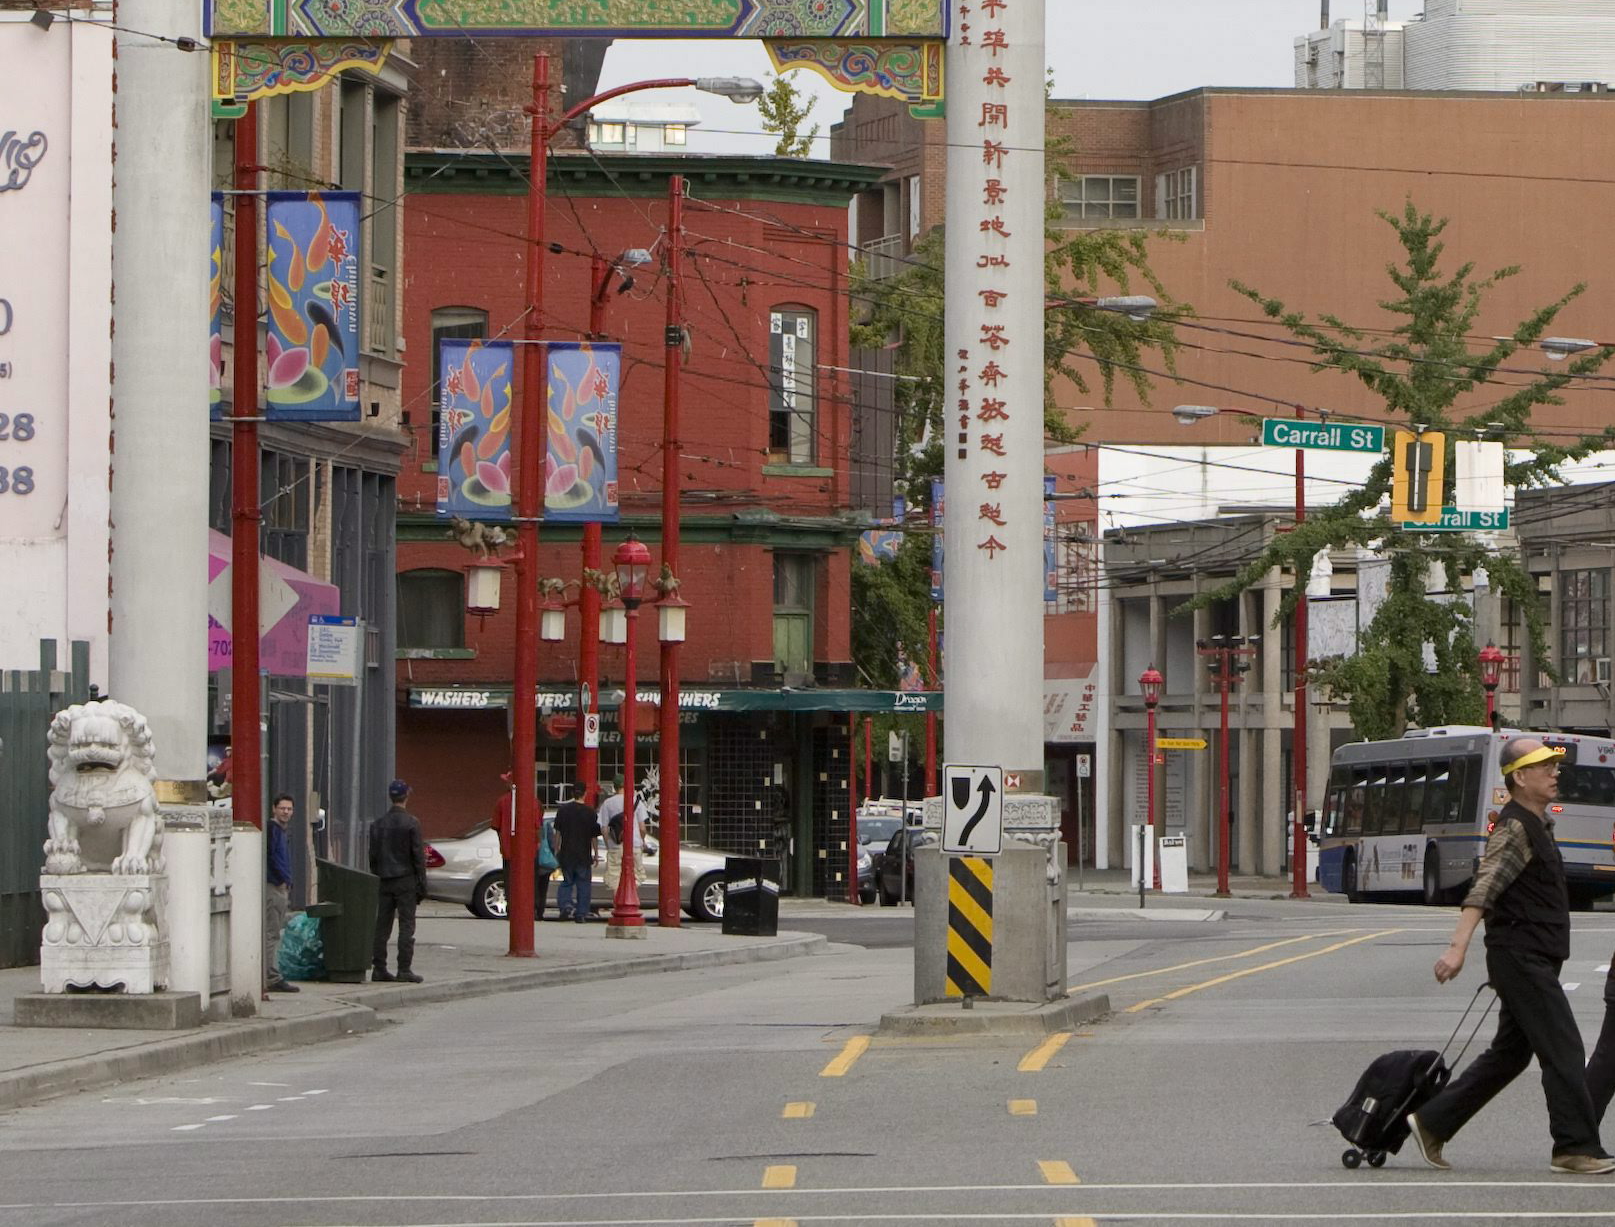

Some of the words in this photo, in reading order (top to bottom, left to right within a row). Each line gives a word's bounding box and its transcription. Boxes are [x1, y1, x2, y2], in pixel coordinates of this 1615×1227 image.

[1273, 424, 1341, 447] Carrall
[1350, 428, 1374, 449] St
[1412, 510, 1471, 527] rrall
[1479, 510, 1500, 527] St
[421, 691, 490, 707] WASHERS
[538, 693, 573, 708] YERS
[894, 692, 927, 708] Dragon
